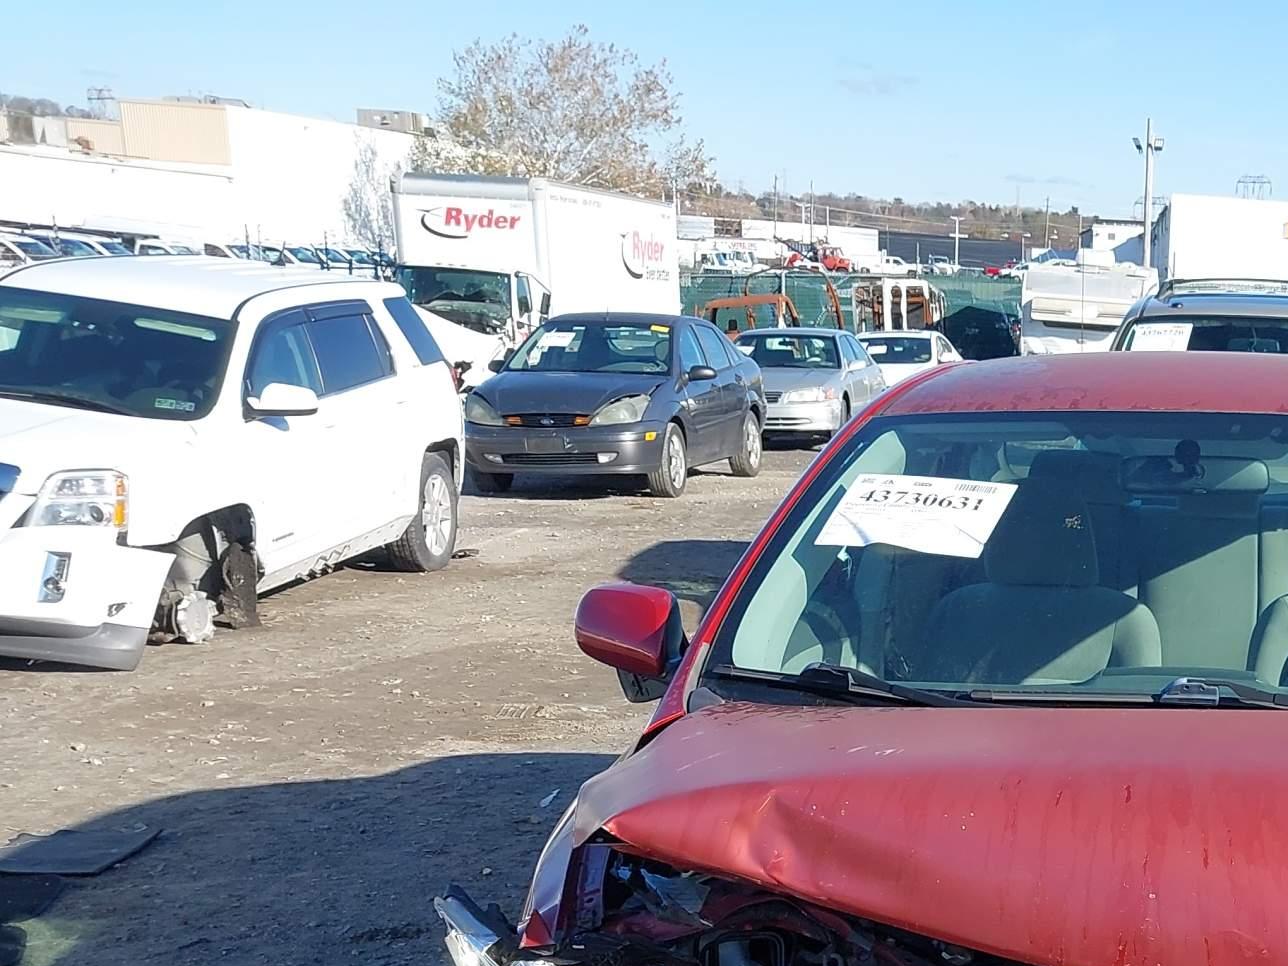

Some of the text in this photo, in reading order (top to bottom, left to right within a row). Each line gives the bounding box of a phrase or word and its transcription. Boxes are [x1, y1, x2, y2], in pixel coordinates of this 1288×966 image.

[444, 206, 521, 233] Ryder
[632, 230, 665, 268] Ryder
[859, 489, 984, 512] 43730631
